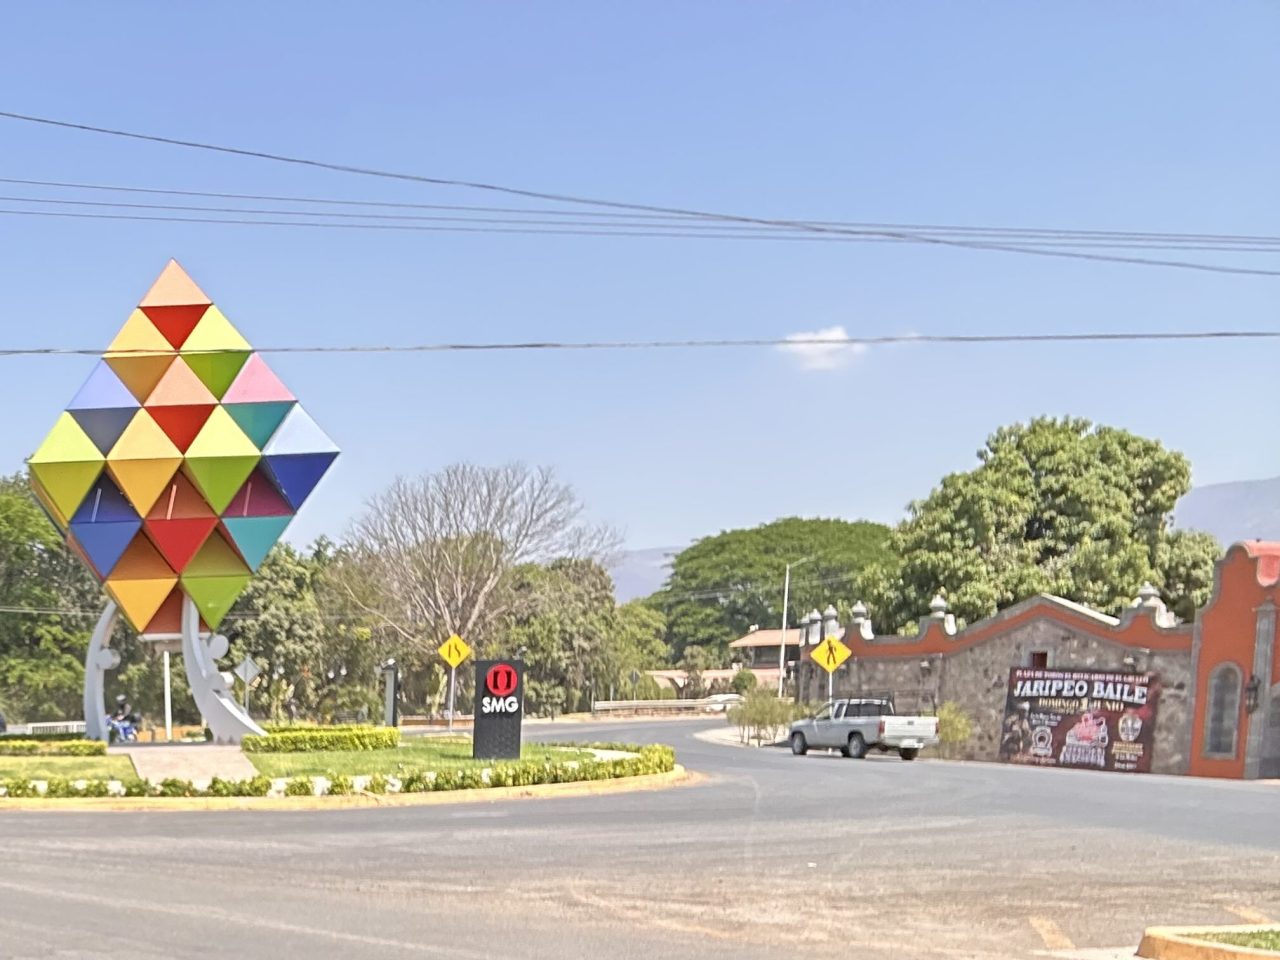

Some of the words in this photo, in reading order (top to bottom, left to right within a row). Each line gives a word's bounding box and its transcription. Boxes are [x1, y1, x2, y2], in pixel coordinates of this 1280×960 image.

[1013, 680, 1088, 698] JARIPEO
[1092, 680, 1148, 705] BAILE
[481, 695, 519, 714] SMG
[1039, 697, 1079, 710] DOMINGO
